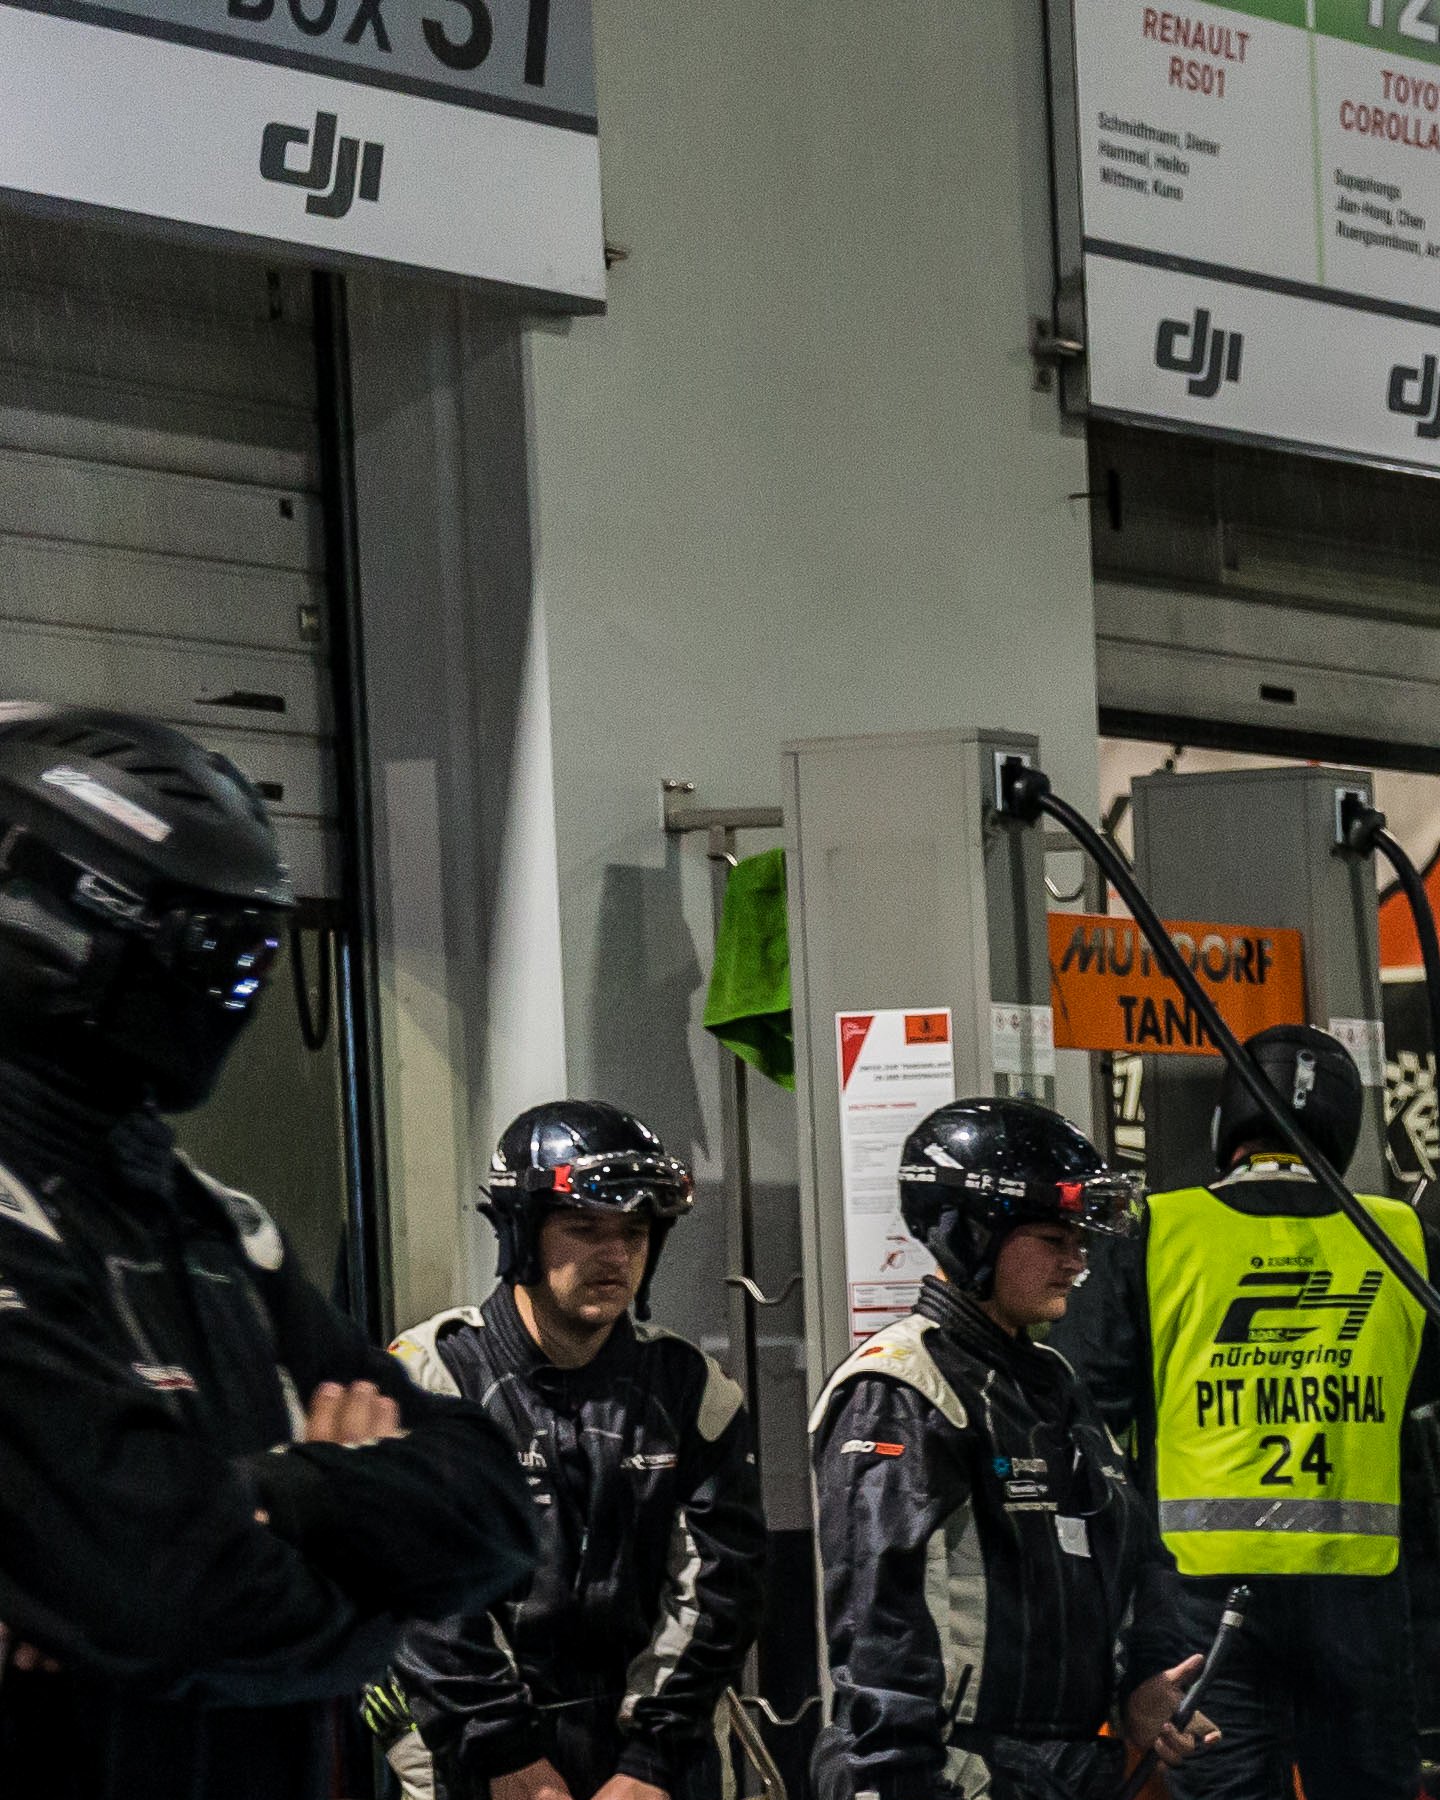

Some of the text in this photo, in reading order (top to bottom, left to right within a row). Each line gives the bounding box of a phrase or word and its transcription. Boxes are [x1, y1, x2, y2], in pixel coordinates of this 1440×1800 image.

[1141, 7, 1250, 64] RENAULT
[1167, 55, 1227, 99] RS01
[1211, 1345, 1353, 1369] nürburgring
[1197, 1375, 1385, 1427] PIT MARSHAL
[1259, 1434, 1333, 1487] 24
